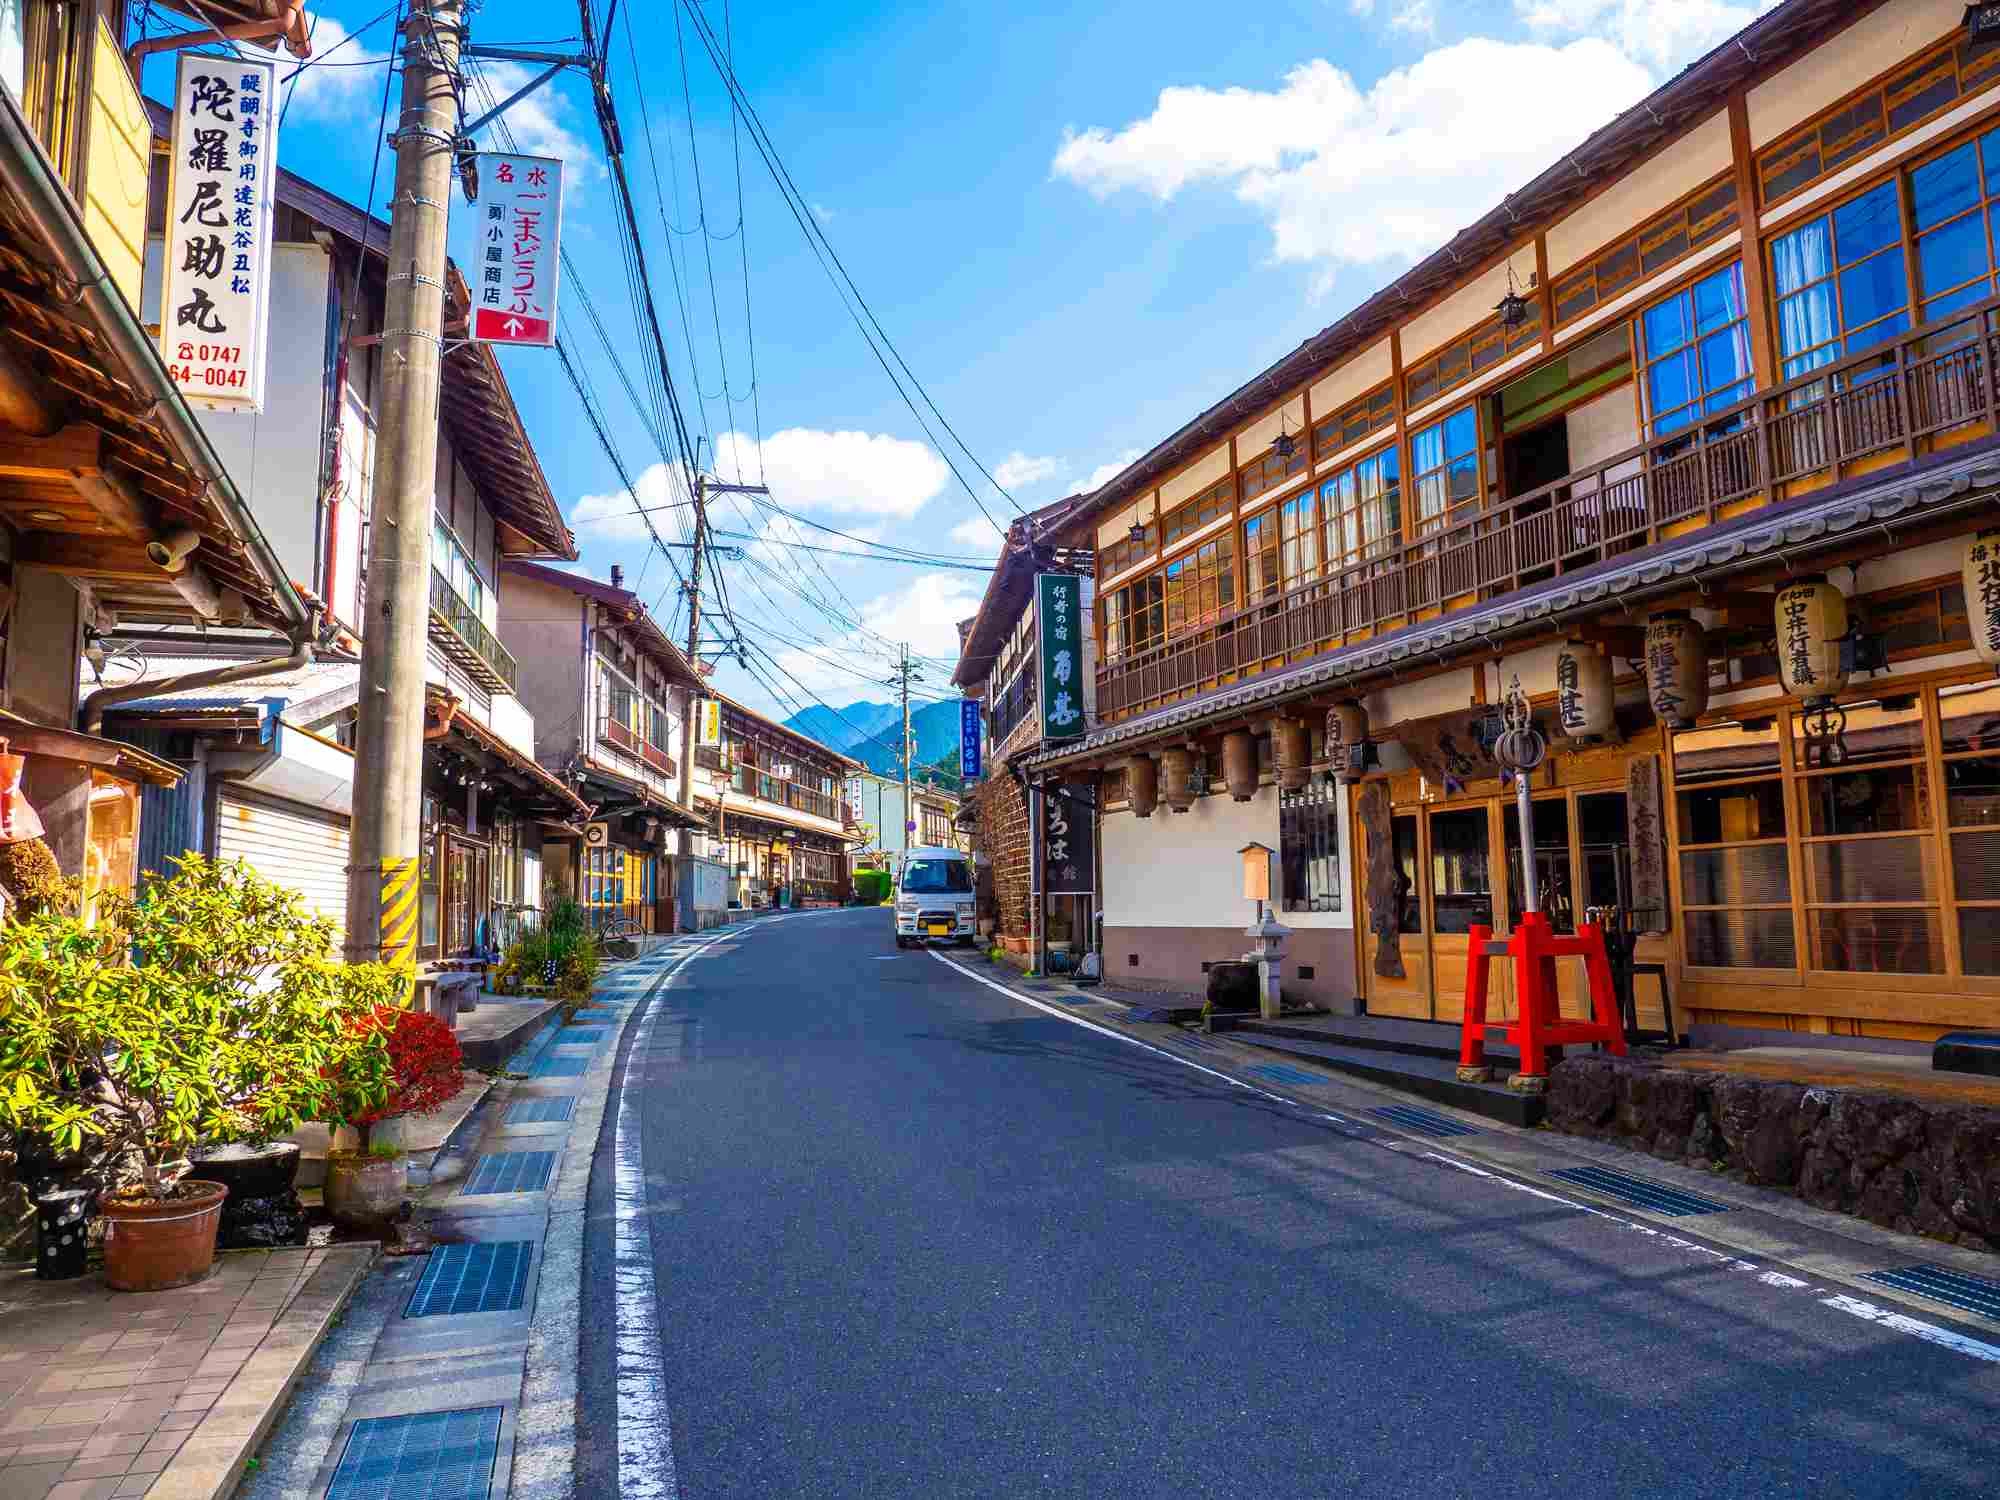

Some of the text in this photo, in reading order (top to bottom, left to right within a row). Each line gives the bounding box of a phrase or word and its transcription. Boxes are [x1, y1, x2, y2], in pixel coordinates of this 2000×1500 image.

[177, 76, 236, 334] 陀羅尼助丸
[510, 193, 546, 314] ごまどうふ
[169, 365, 247, 388] 64-0047
[199, 345, 241, 363] 0747
